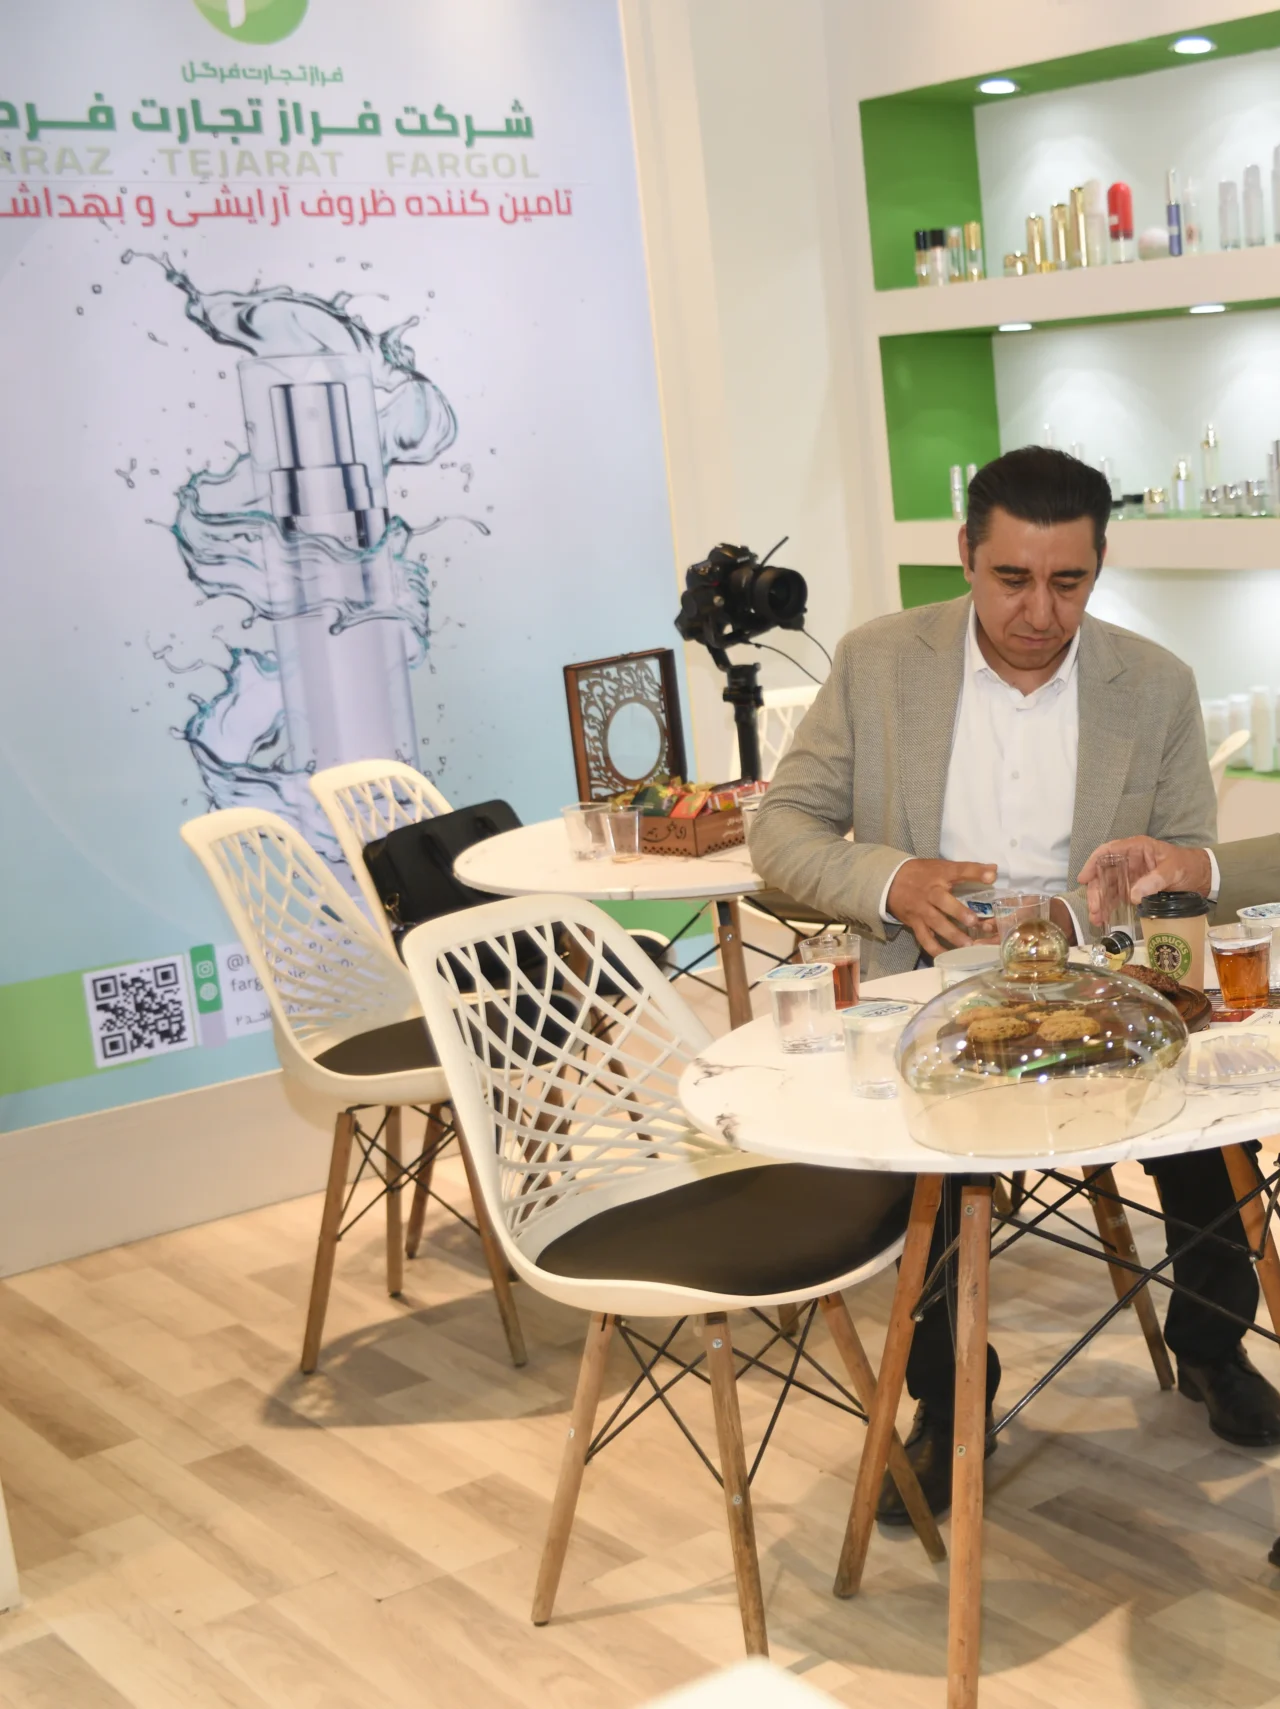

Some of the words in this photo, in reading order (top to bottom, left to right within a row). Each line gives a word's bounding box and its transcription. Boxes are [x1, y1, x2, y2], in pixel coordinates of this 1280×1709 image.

[131, 97, 263, 145] تجارت
[278, 98, 382, 147] فراز
[395, 99, 534, 148] شرکت
[0, 146, 114, 175] ARAZ
[157, 148, 343, 177] TEJARAT
[386, 151, 540, 178] FARGOL
[0, 180, 125, 224] بهداش
[135, 195, 155, 227] و
[166, 184, 289, 227] آرایشی
[300, 188, 396, 226] ظروف
[404, 189, 490, 217] کننده
[499, 188, 573, 224] تامین
[1149, 936, 1189, 955] STARBUCKS
